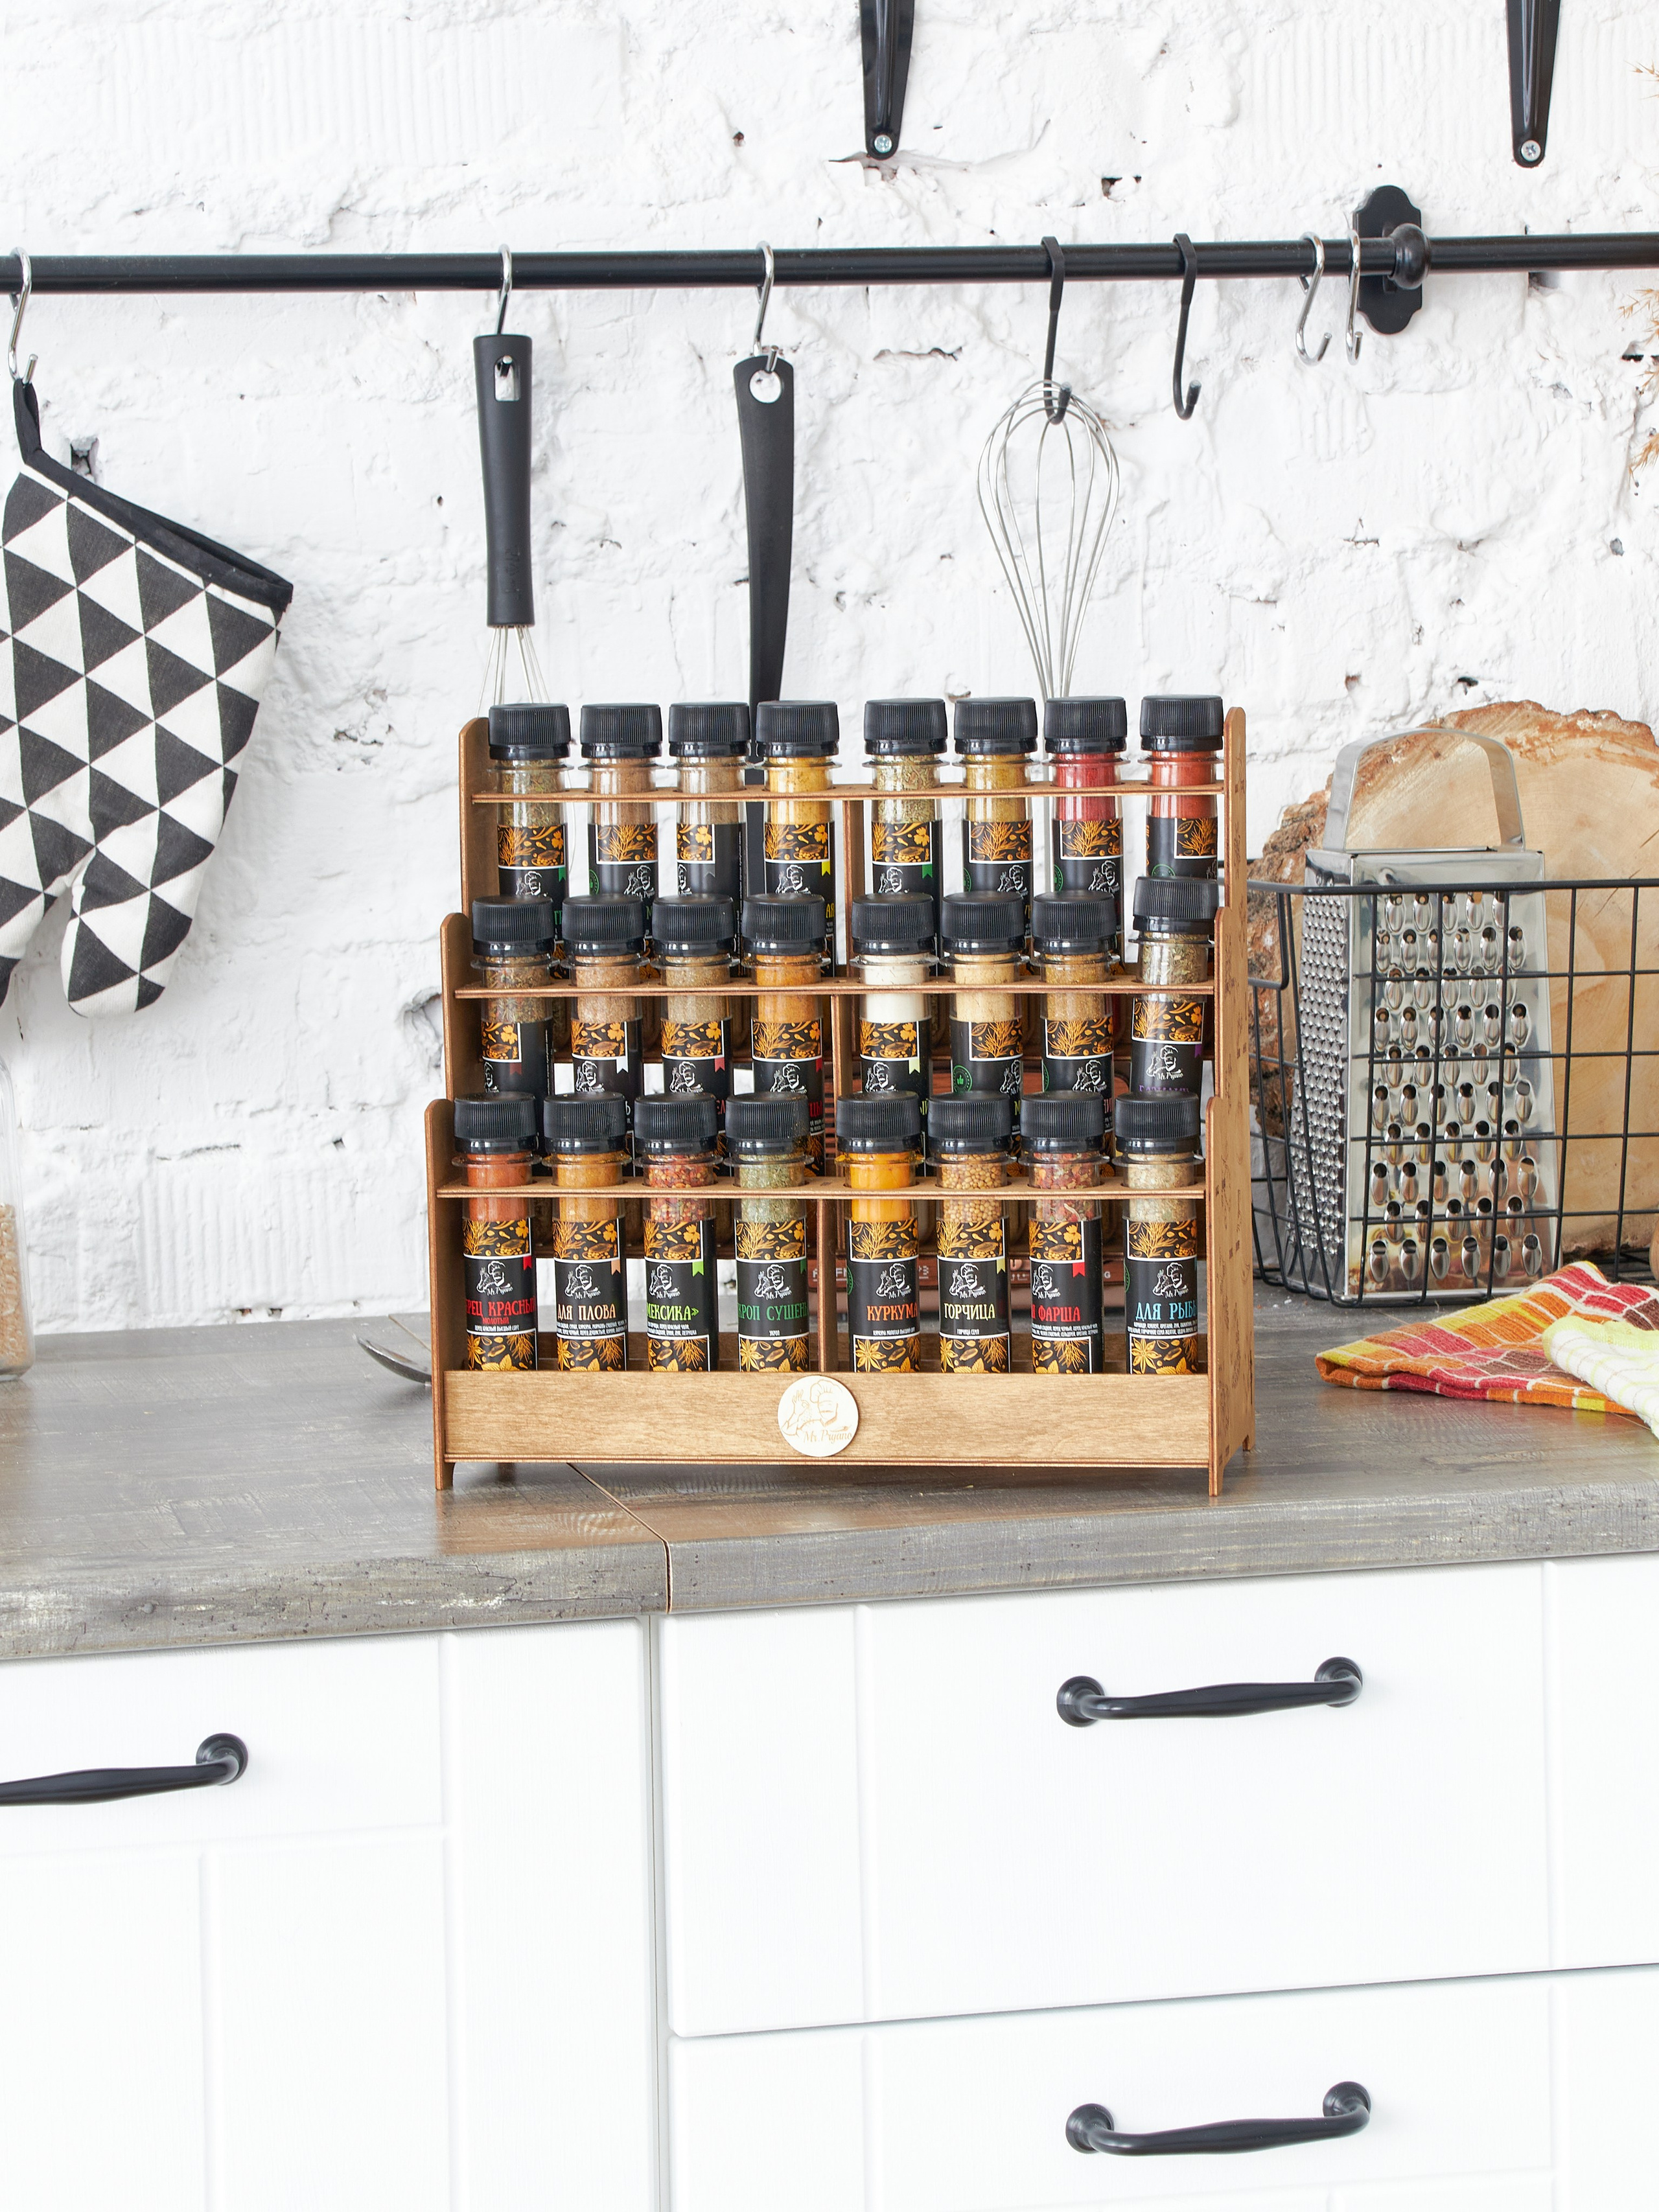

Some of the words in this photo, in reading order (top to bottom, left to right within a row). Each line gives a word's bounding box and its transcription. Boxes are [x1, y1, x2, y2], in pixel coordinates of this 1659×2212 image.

[482, 1316, 510, 1325] МОЛОТЫЙ
[558, 1303, 573, 1321] ДЛЯ
[578, 1303, 616, 1321] ПЛОВА
[737, 1302, 760, 1321] КРОП
[866, 1301, 918, 1321] КУРКУМА
[944, 1302, 995, 1321] ГОРЧИЦА
[1038, 1304, 1081, 1322] ФАРША
[1135, 1302, 1162, 1322] ДЛЯ
